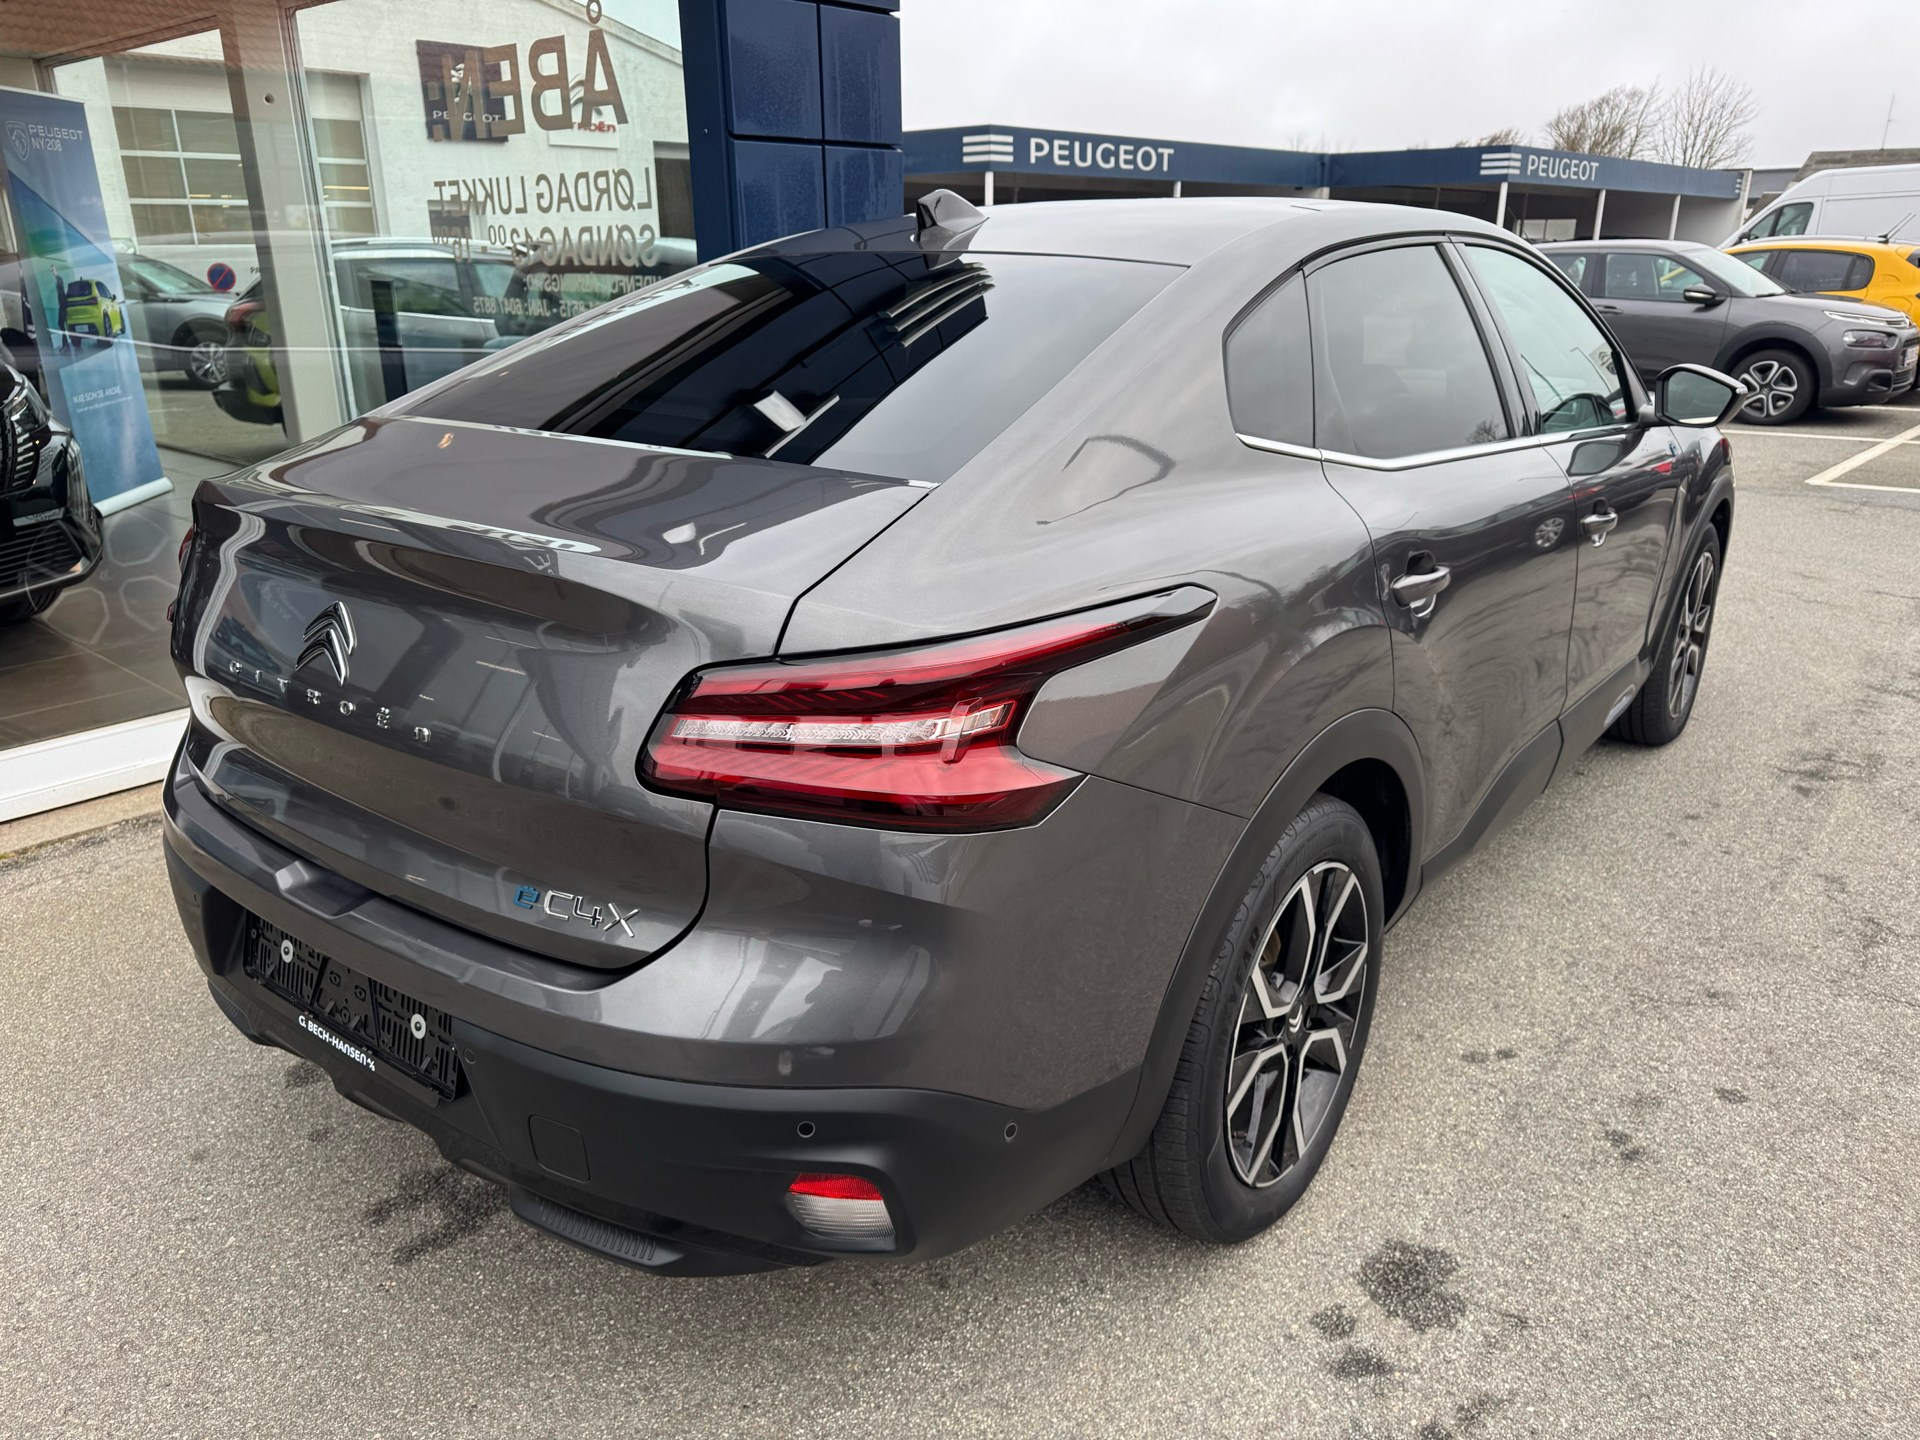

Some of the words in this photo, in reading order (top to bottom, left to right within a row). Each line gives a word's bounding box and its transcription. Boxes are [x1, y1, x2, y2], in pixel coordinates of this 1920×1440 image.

[28, 124, 83, 140] PEUGEOT
[31, 137, 44, 149] NY
[45, 138, 63, 151] 208
[1029, 137, 1175, 172] PEUGEOT
[1526, 154, 1599, 181] PEUGEOT
[307, 1020, 367, 1066] BECH-HANSEN
